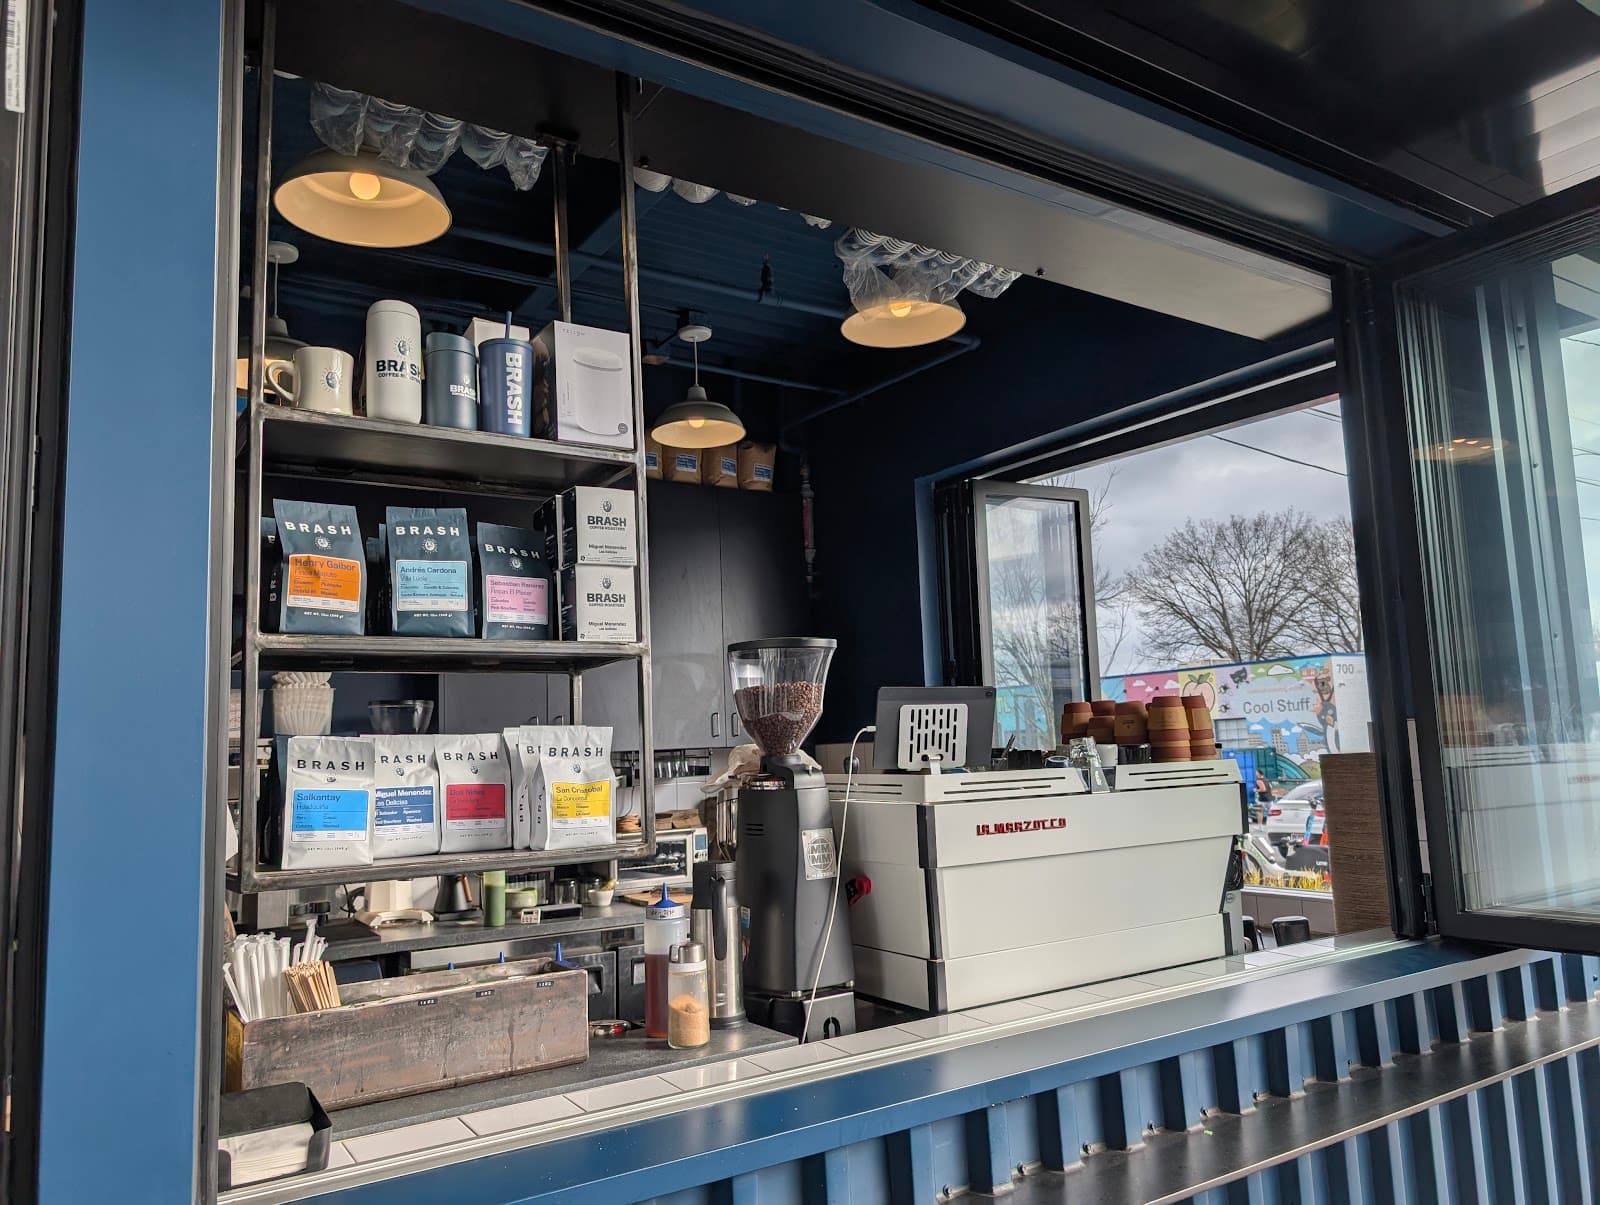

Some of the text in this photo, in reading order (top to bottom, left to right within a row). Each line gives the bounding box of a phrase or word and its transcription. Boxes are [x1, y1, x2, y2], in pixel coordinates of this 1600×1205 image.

[505, 352, 523, 425] BRASH
[587, 516, 626, 527] BRASH
[284, 521, 352, 536] BRASH
[395, 526, 460, 536] BRASH
[484, 544, 540, 560] BRASH
[295, 558, 325, 569] Henry
[586, 593, 626, 604] BRASH
[1337, 664, 1354, 674] 700
[1243, 697, 1310, 714] Cool Stuff
[444, 752, 498, 761] BRASH
[549, 747, 604, 757] BRASH
[375, 754, 426, 764] RASH
[297, 760, 365, 771] BRASH
[296, 793, 340, 802] Salkantay
[398, 789, 432, 797] Menendez
